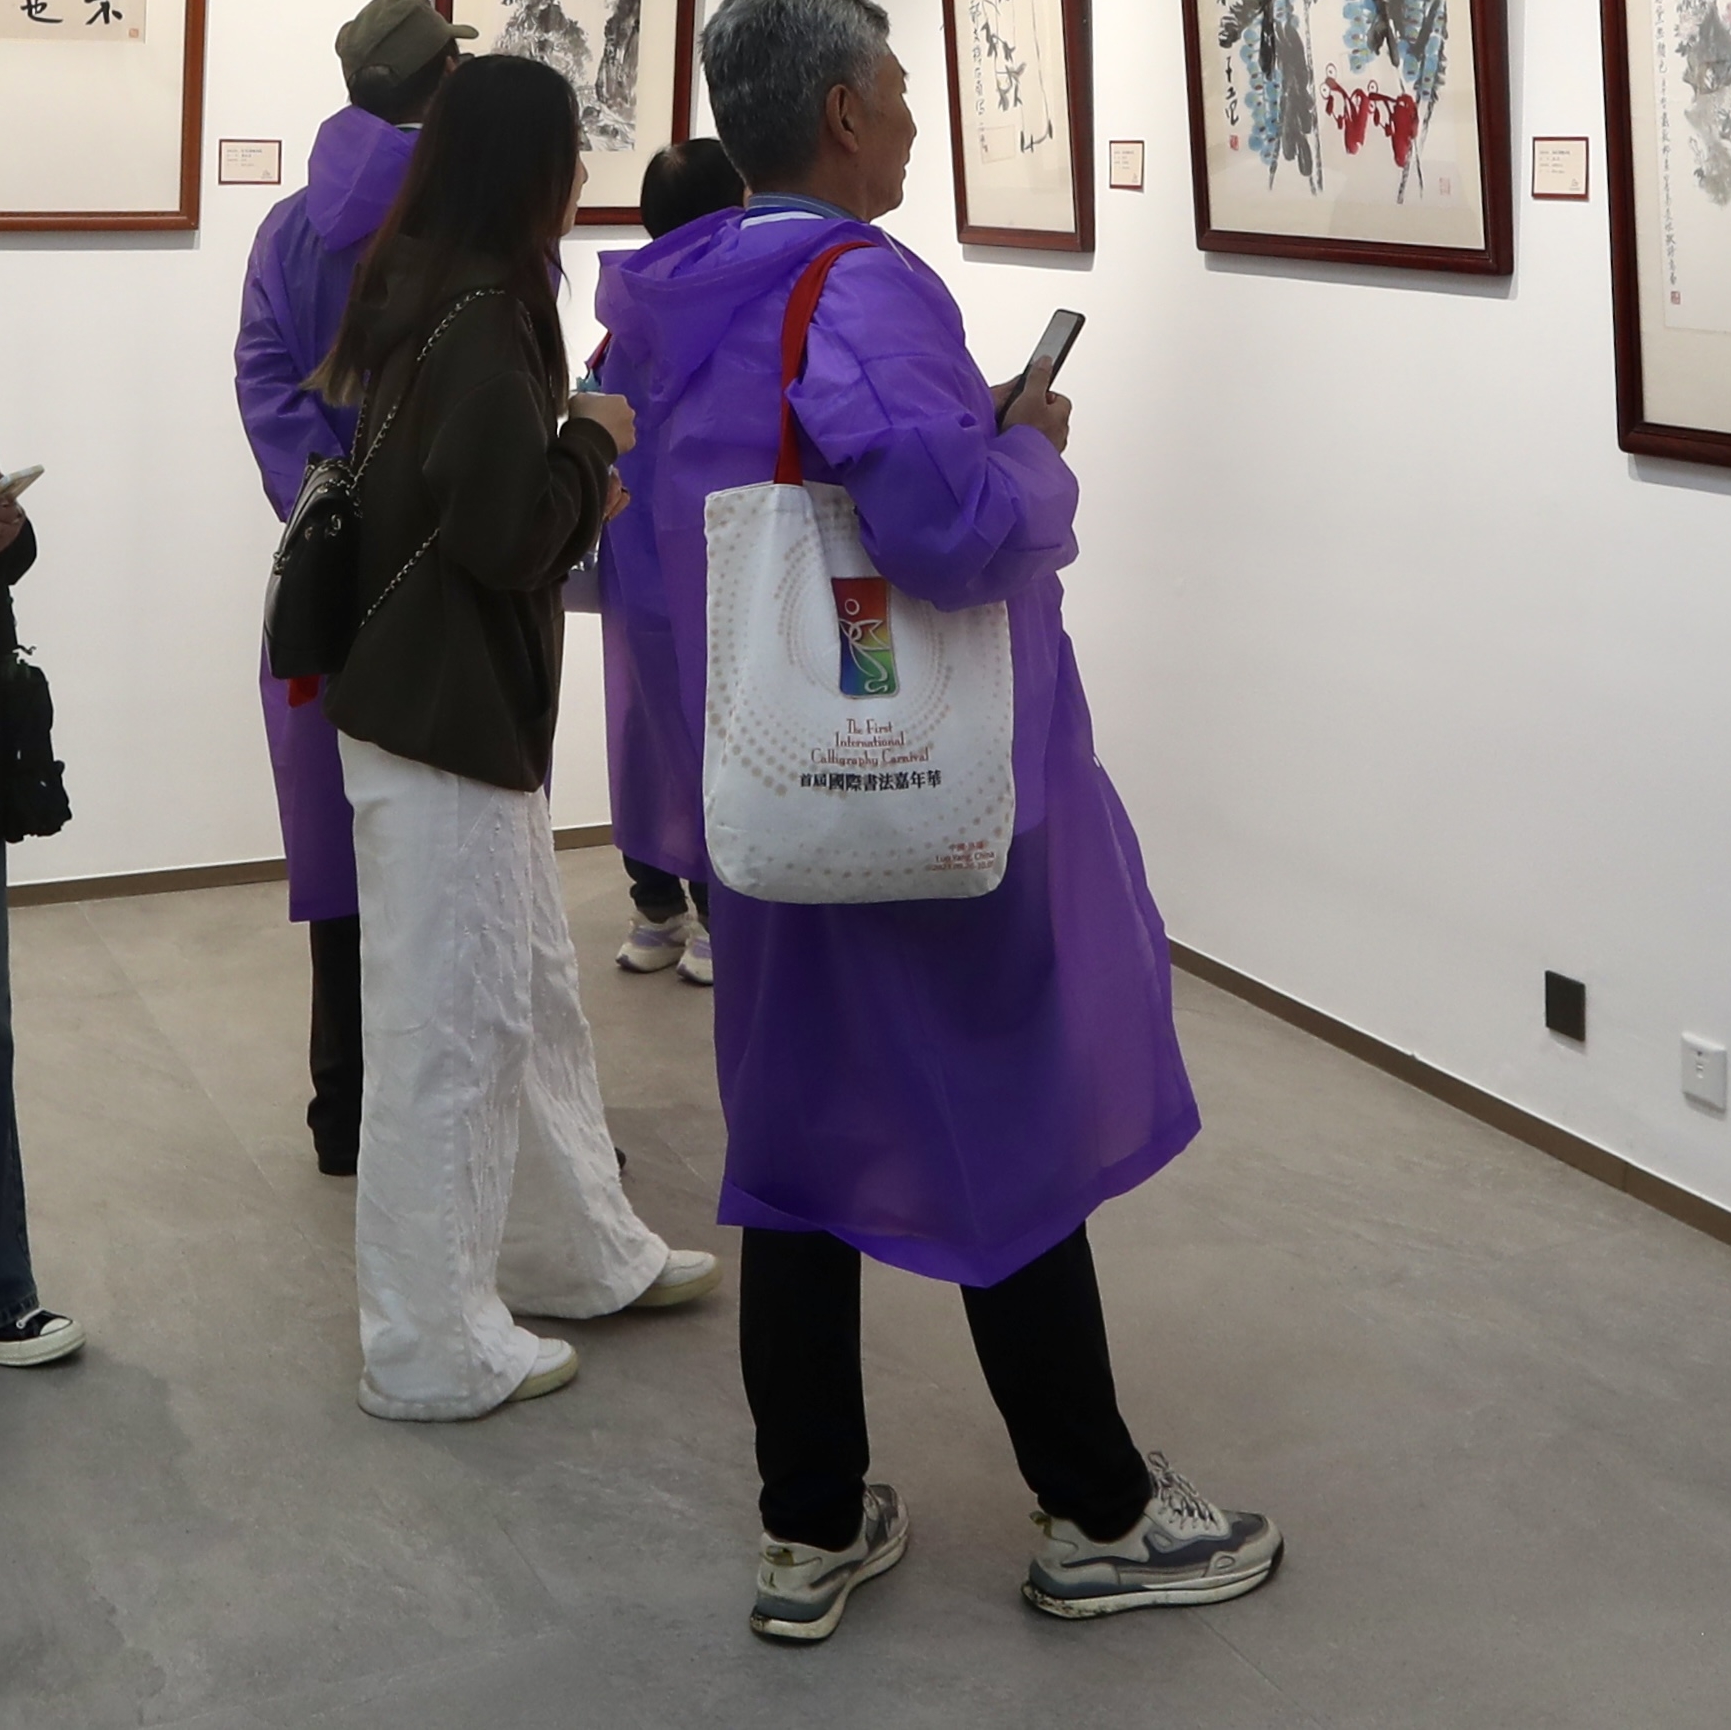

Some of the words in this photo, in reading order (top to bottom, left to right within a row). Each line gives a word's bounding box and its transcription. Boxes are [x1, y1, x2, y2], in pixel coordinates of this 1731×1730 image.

[846, 717, 863, 735] The
[866, 717, 893, 735] First
[834, 731, 906, 748] International
[810, 747, 879, 767] Calligraphy
[881, 746, 930, 765] Carnival
